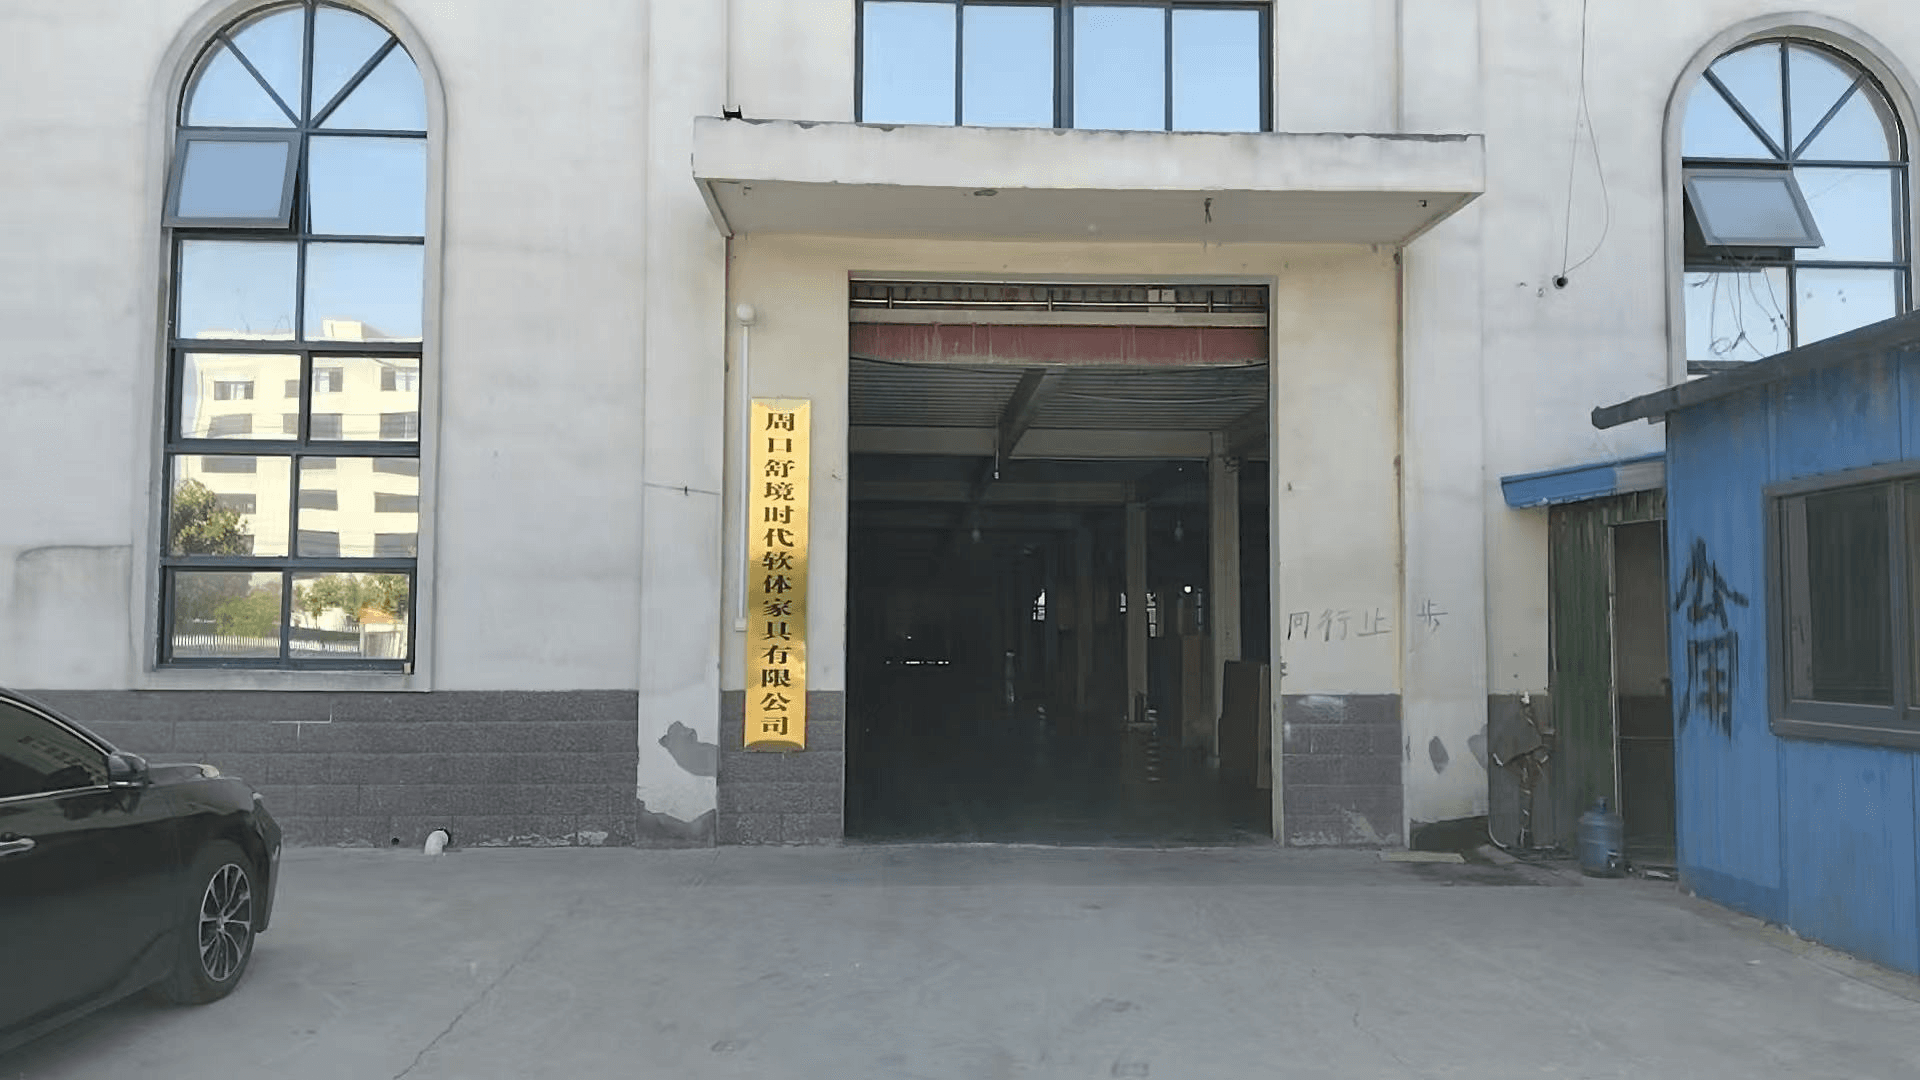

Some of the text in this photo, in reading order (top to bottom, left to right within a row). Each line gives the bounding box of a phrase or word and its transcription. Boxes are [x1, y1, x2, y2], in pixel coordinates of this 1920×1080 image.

[760, 412, 795, 736] 周口舒境时代软体家具有限公司
[1674, 537, 1749, 741] 公用
